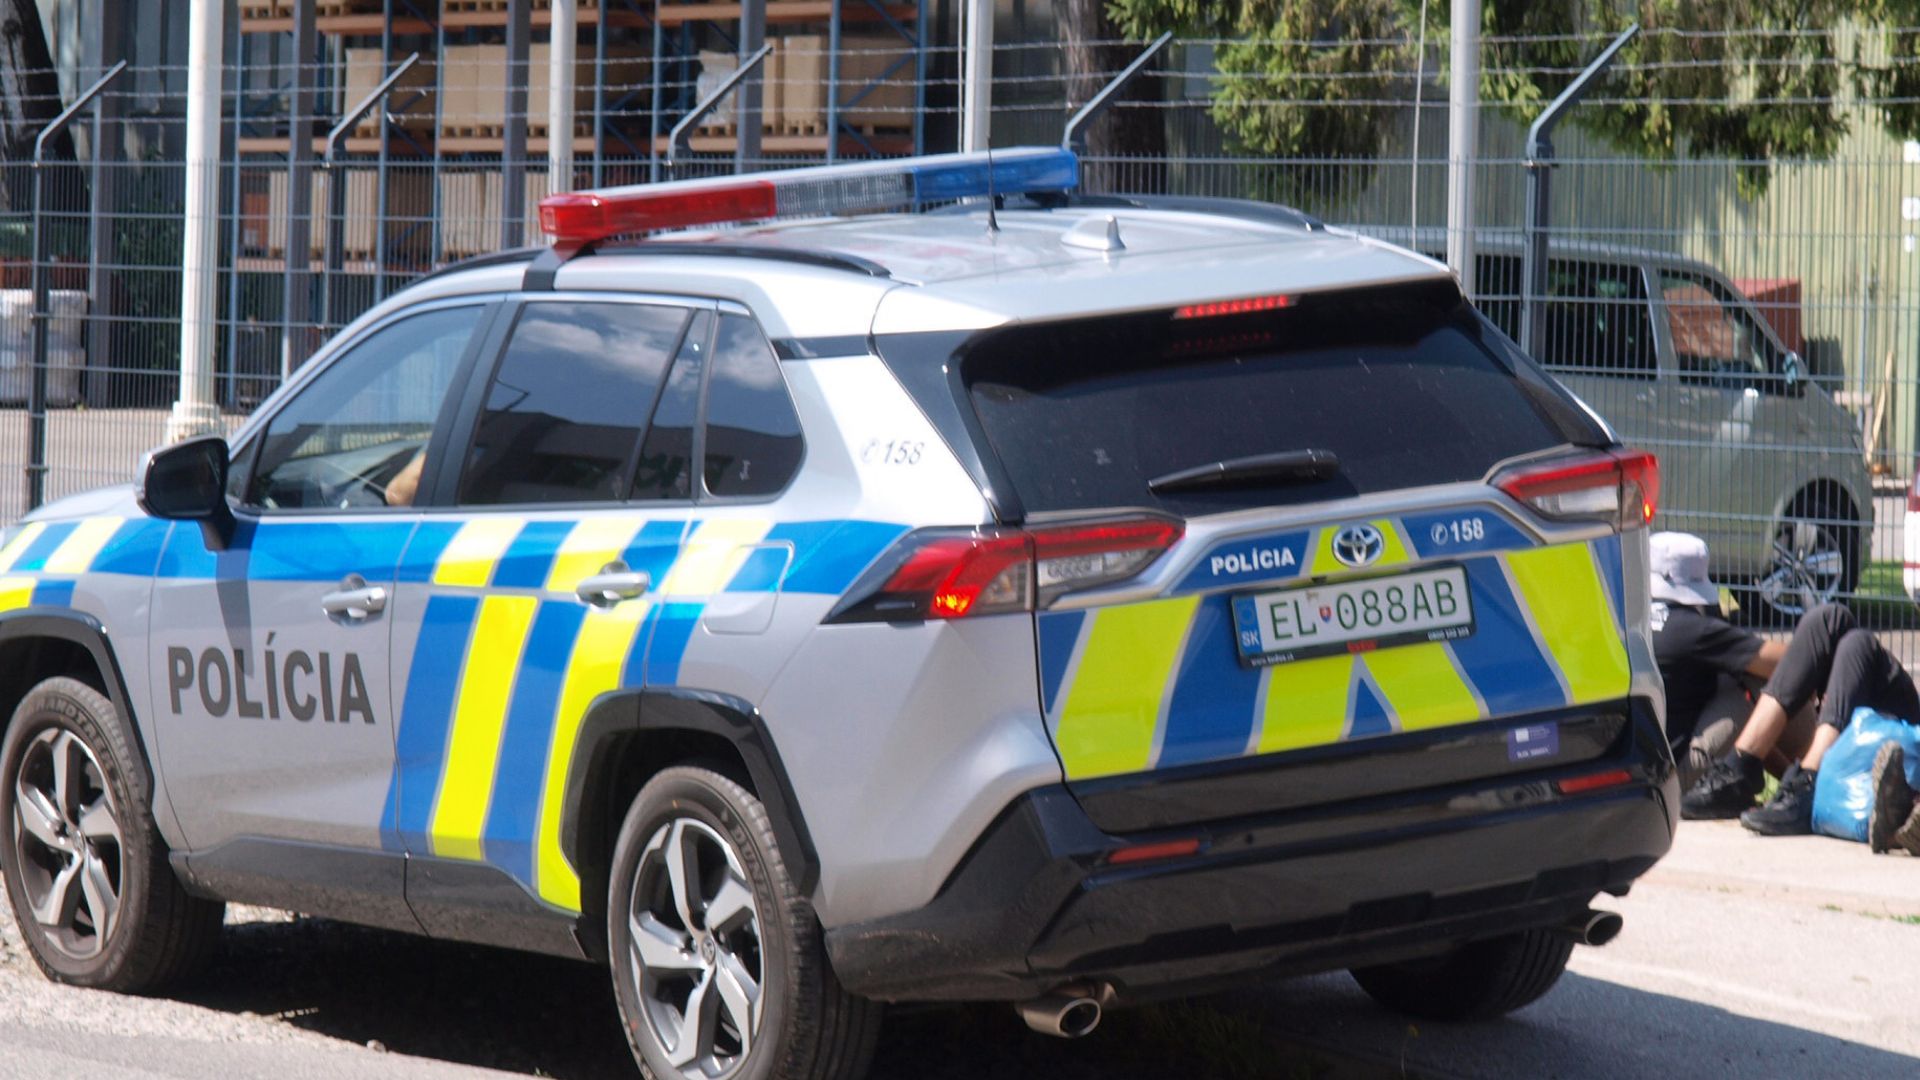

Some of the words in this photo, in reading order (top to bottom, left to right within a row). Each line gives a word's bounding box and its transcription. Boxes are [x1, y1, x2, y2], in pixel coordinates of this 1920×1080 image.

[884, 440, 925, 465] 158
[1450, 517, 1485, 543] 158
[1210, 547, 1296, 576] POLÍCIA
[1269, 600, 1317, 641] EL
[1336, 579, 1458, 630] 088AB
[1241, 630, 1260, 648] SK
[167, 631, 376, 725] POLÍCIA
